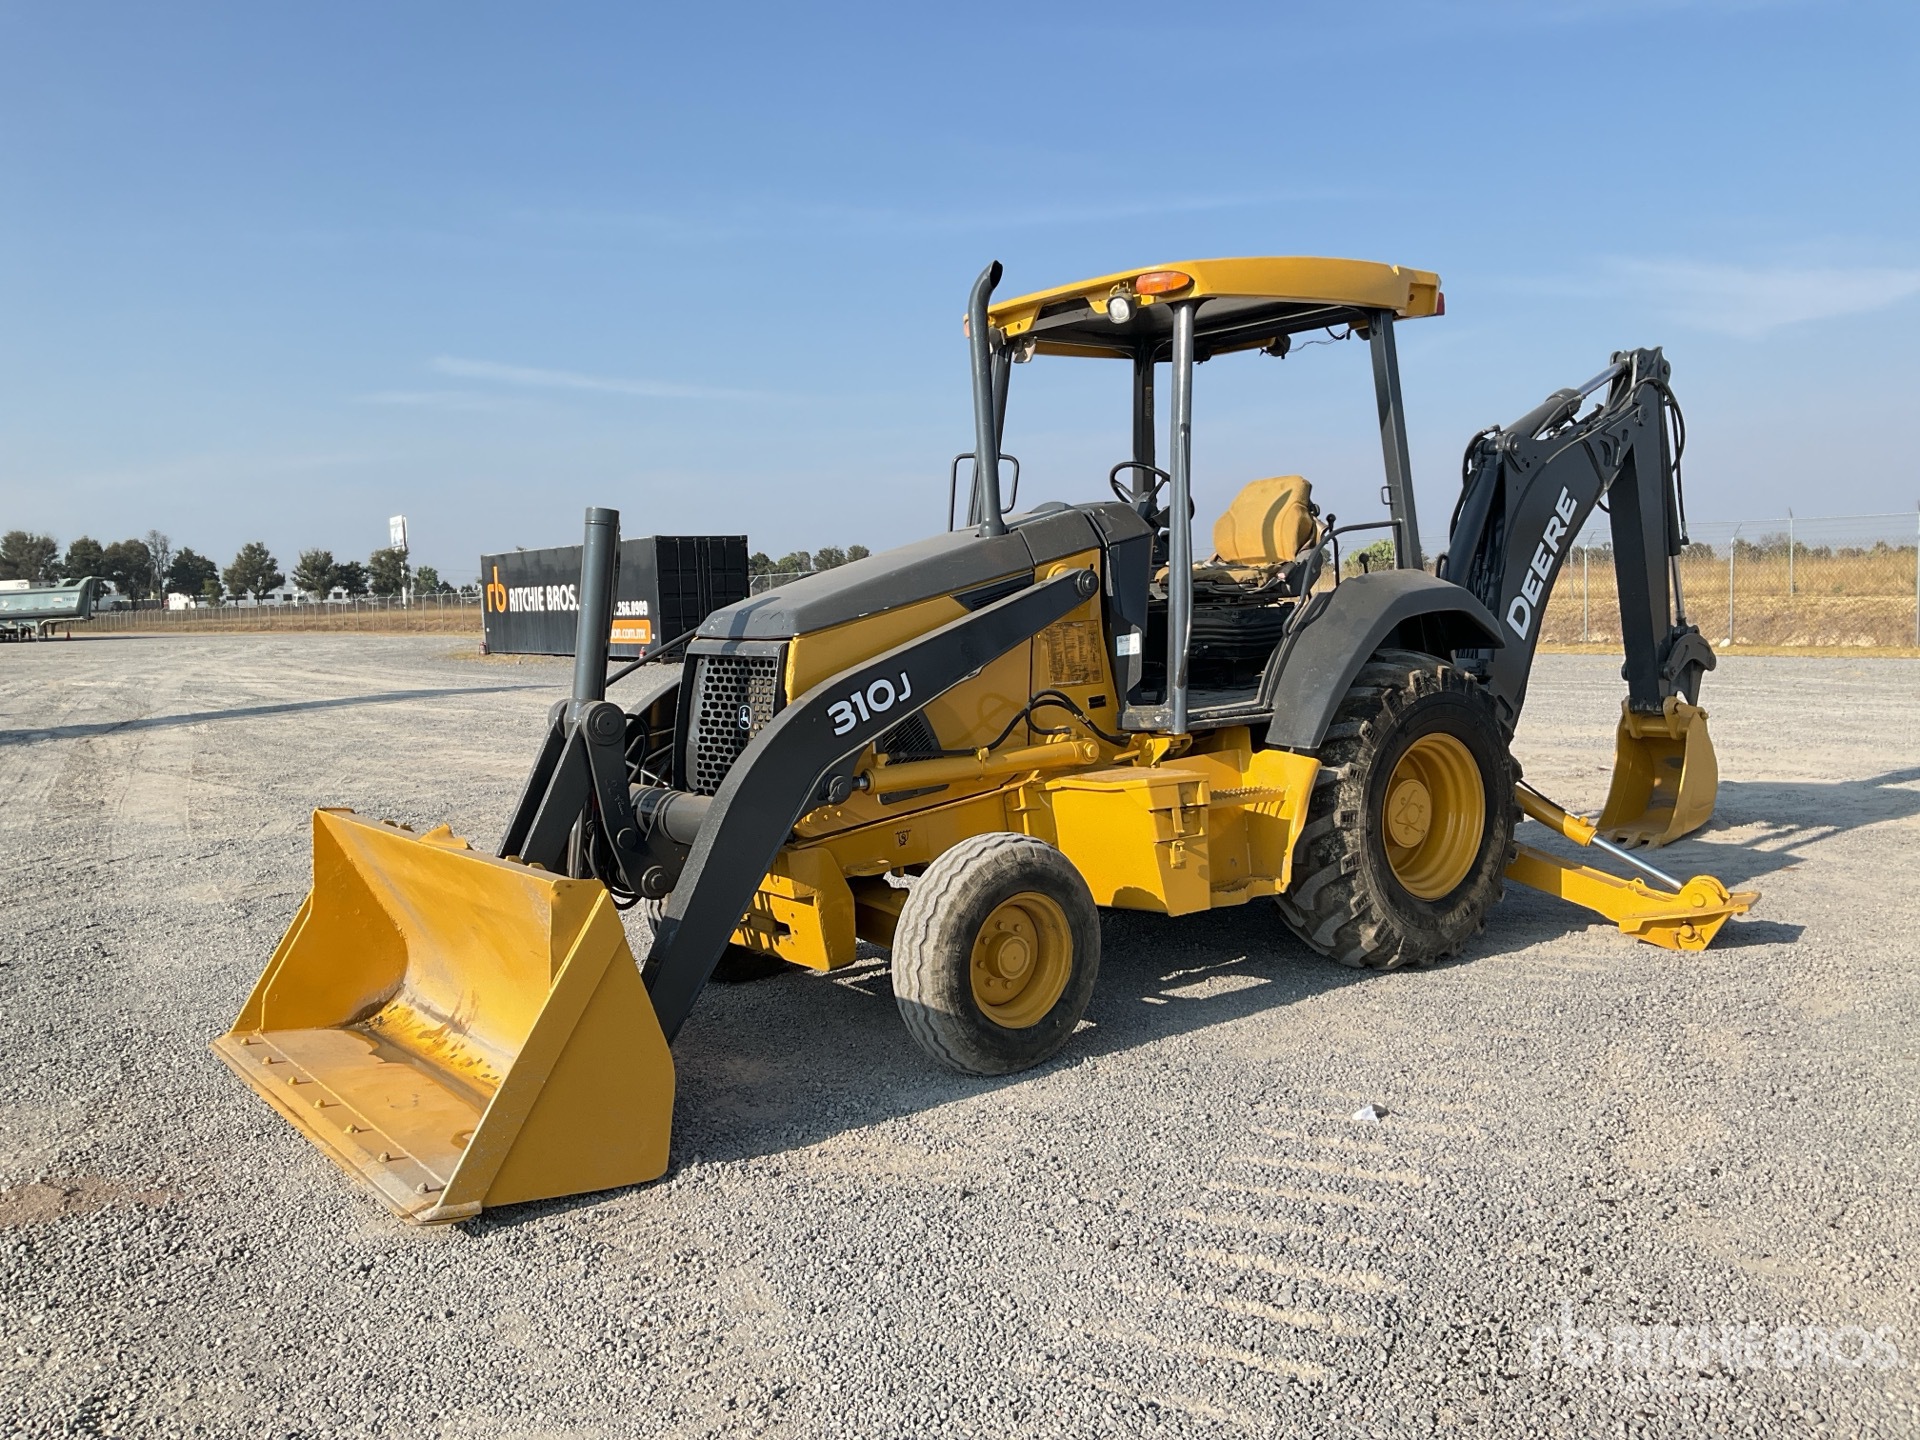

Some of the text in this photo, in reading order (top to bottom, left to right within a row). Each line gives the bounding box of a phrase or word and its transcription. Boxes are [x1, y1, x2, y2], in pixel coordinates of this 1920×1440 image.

[1506, 486, 1578, 641] DEERE
[508, 586, 545, 612] RITCHIE
[546, 584, 580, 611] BROS.
[613, 600, 649, 616] .266.0909
[827, 671, 912, 736] 310J
